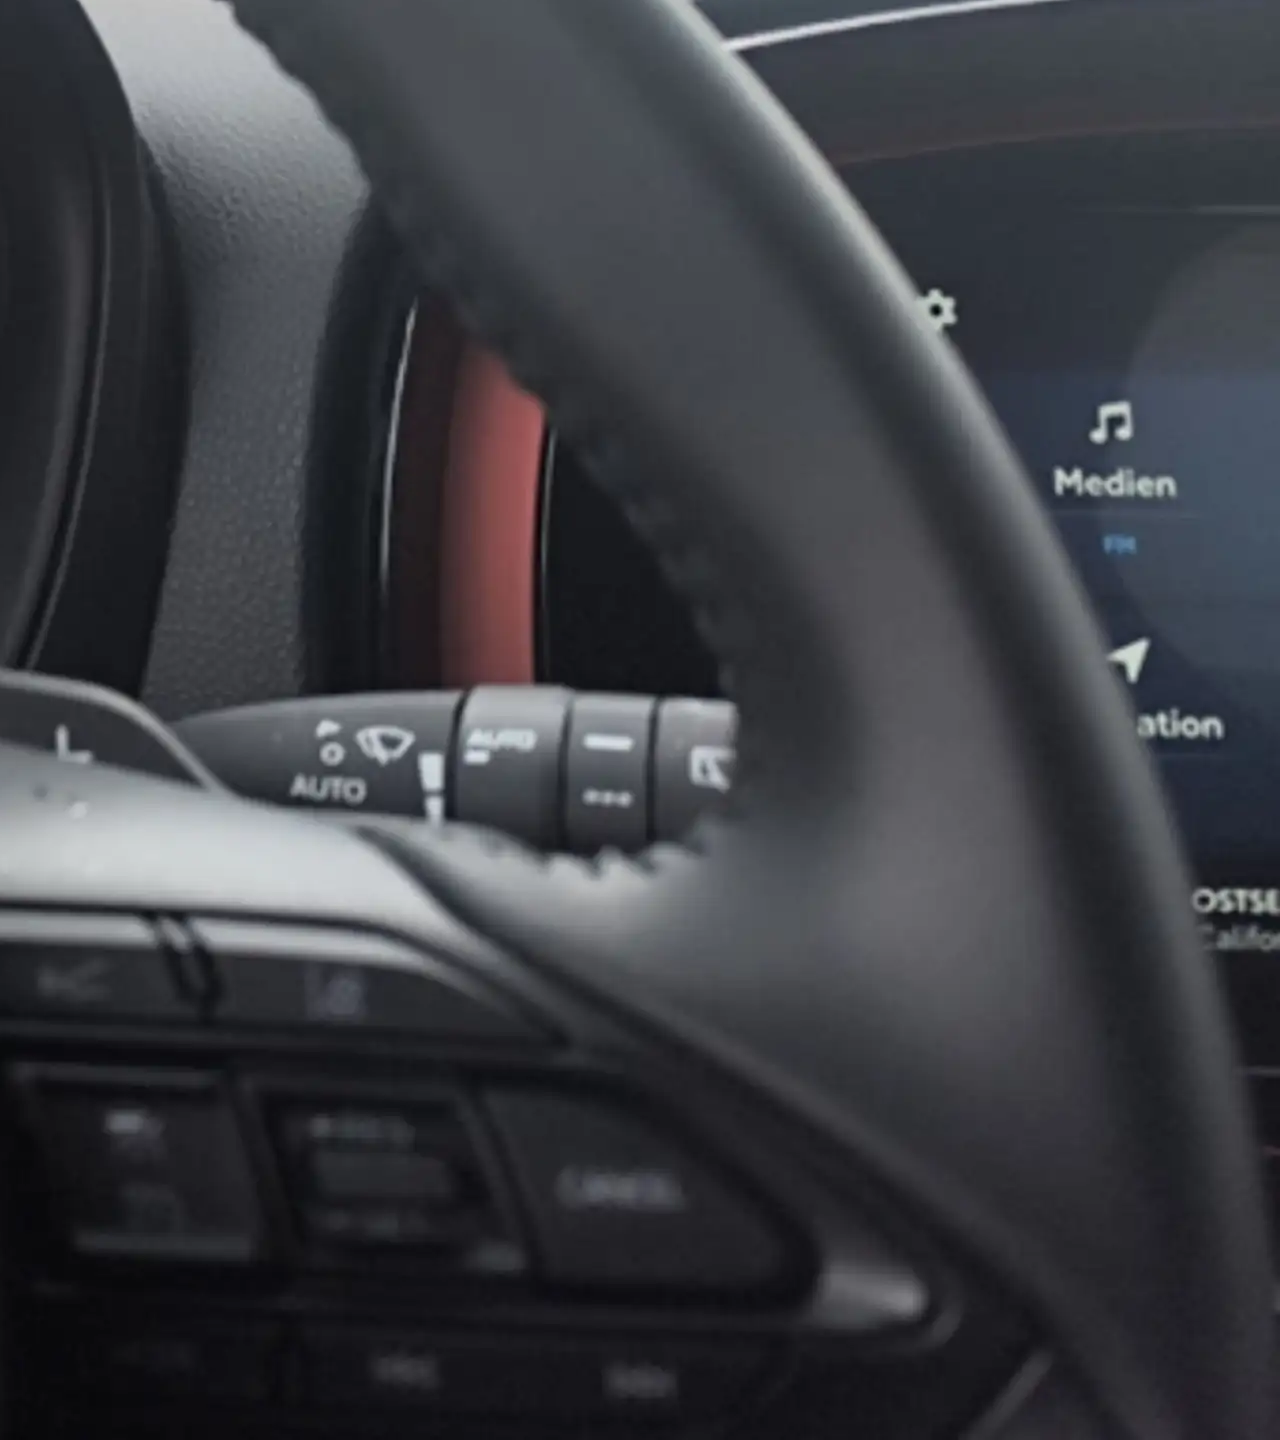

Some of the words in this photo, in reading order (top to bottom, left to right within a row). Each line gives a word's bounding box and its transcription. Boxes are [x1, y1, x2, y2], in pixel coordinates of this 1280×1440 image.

[1053, 465, 1178, 500] Medien
[466, 729, 538, 752] AUTO
[289, 774, 368, 806] AUTO
